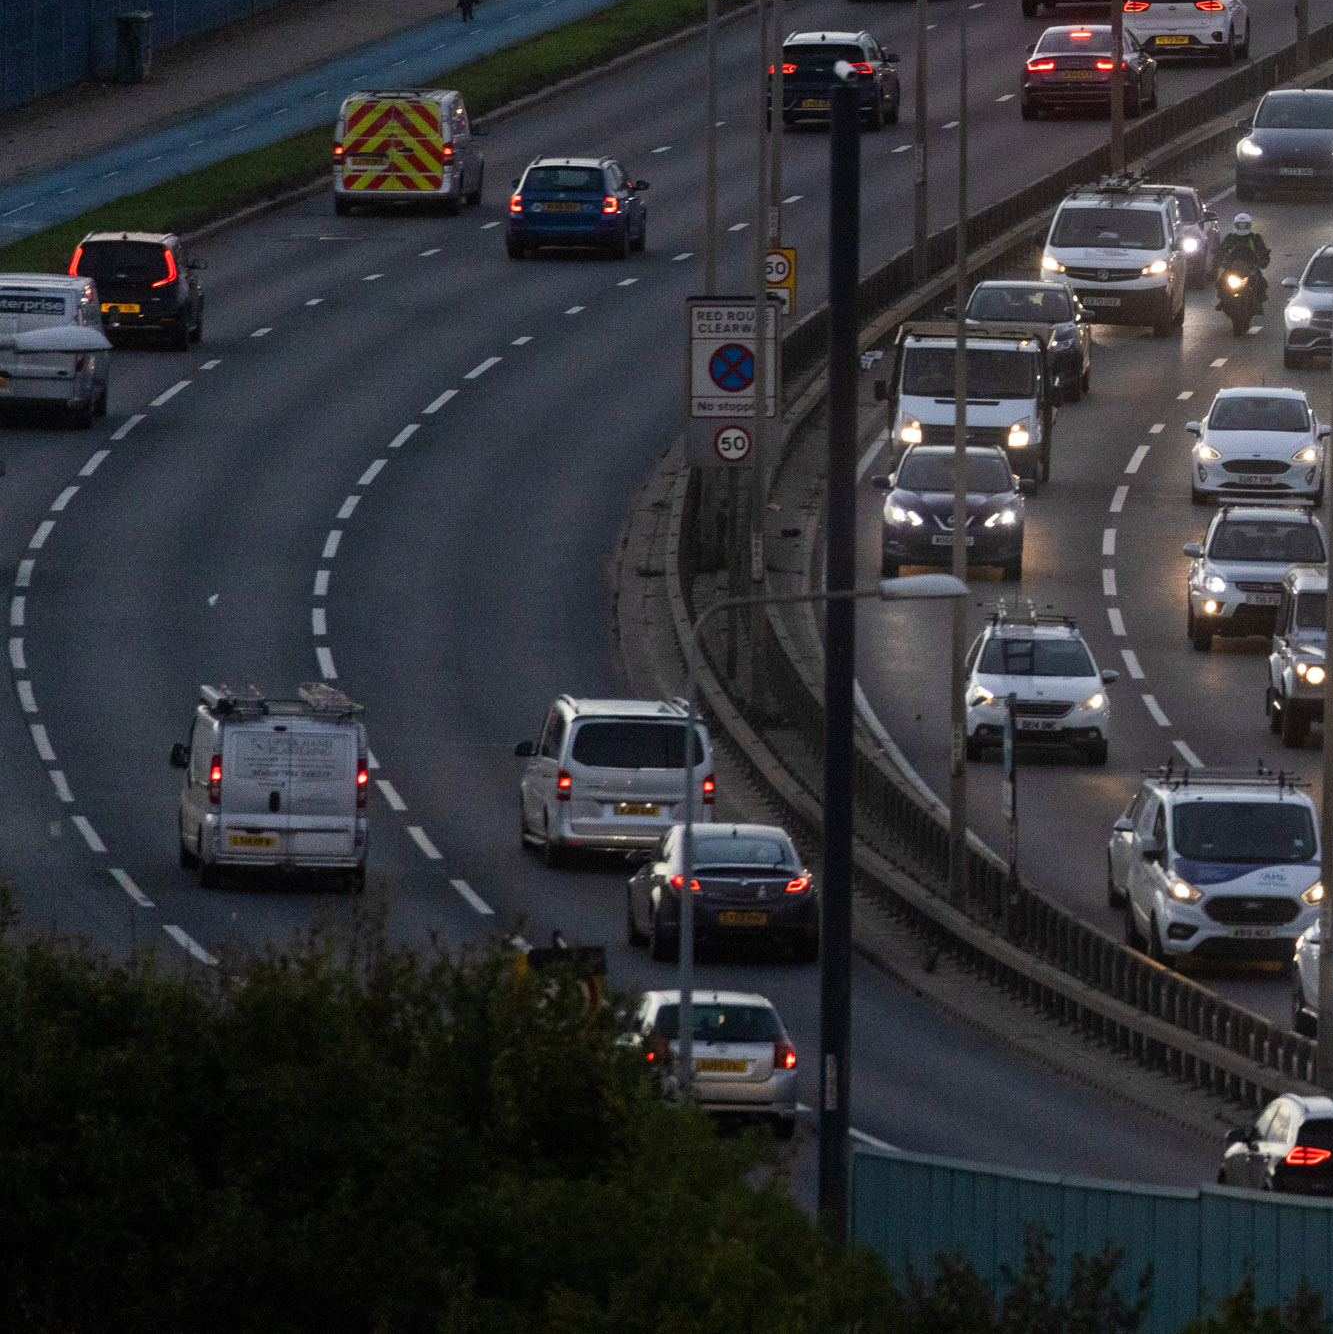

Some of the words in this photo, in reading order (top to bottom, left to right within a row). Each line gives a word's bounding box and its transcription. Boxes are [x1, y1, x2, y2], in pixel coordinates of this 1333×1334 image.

[765, 261, 787, 275] 50
[0, 298, 64, 312] terprise
[697, 311, 723, 321] RED
[727, 311, 770, 321] ROUE
[697, 401, 714, 411] No
[721, 436, 746, 451] 50
